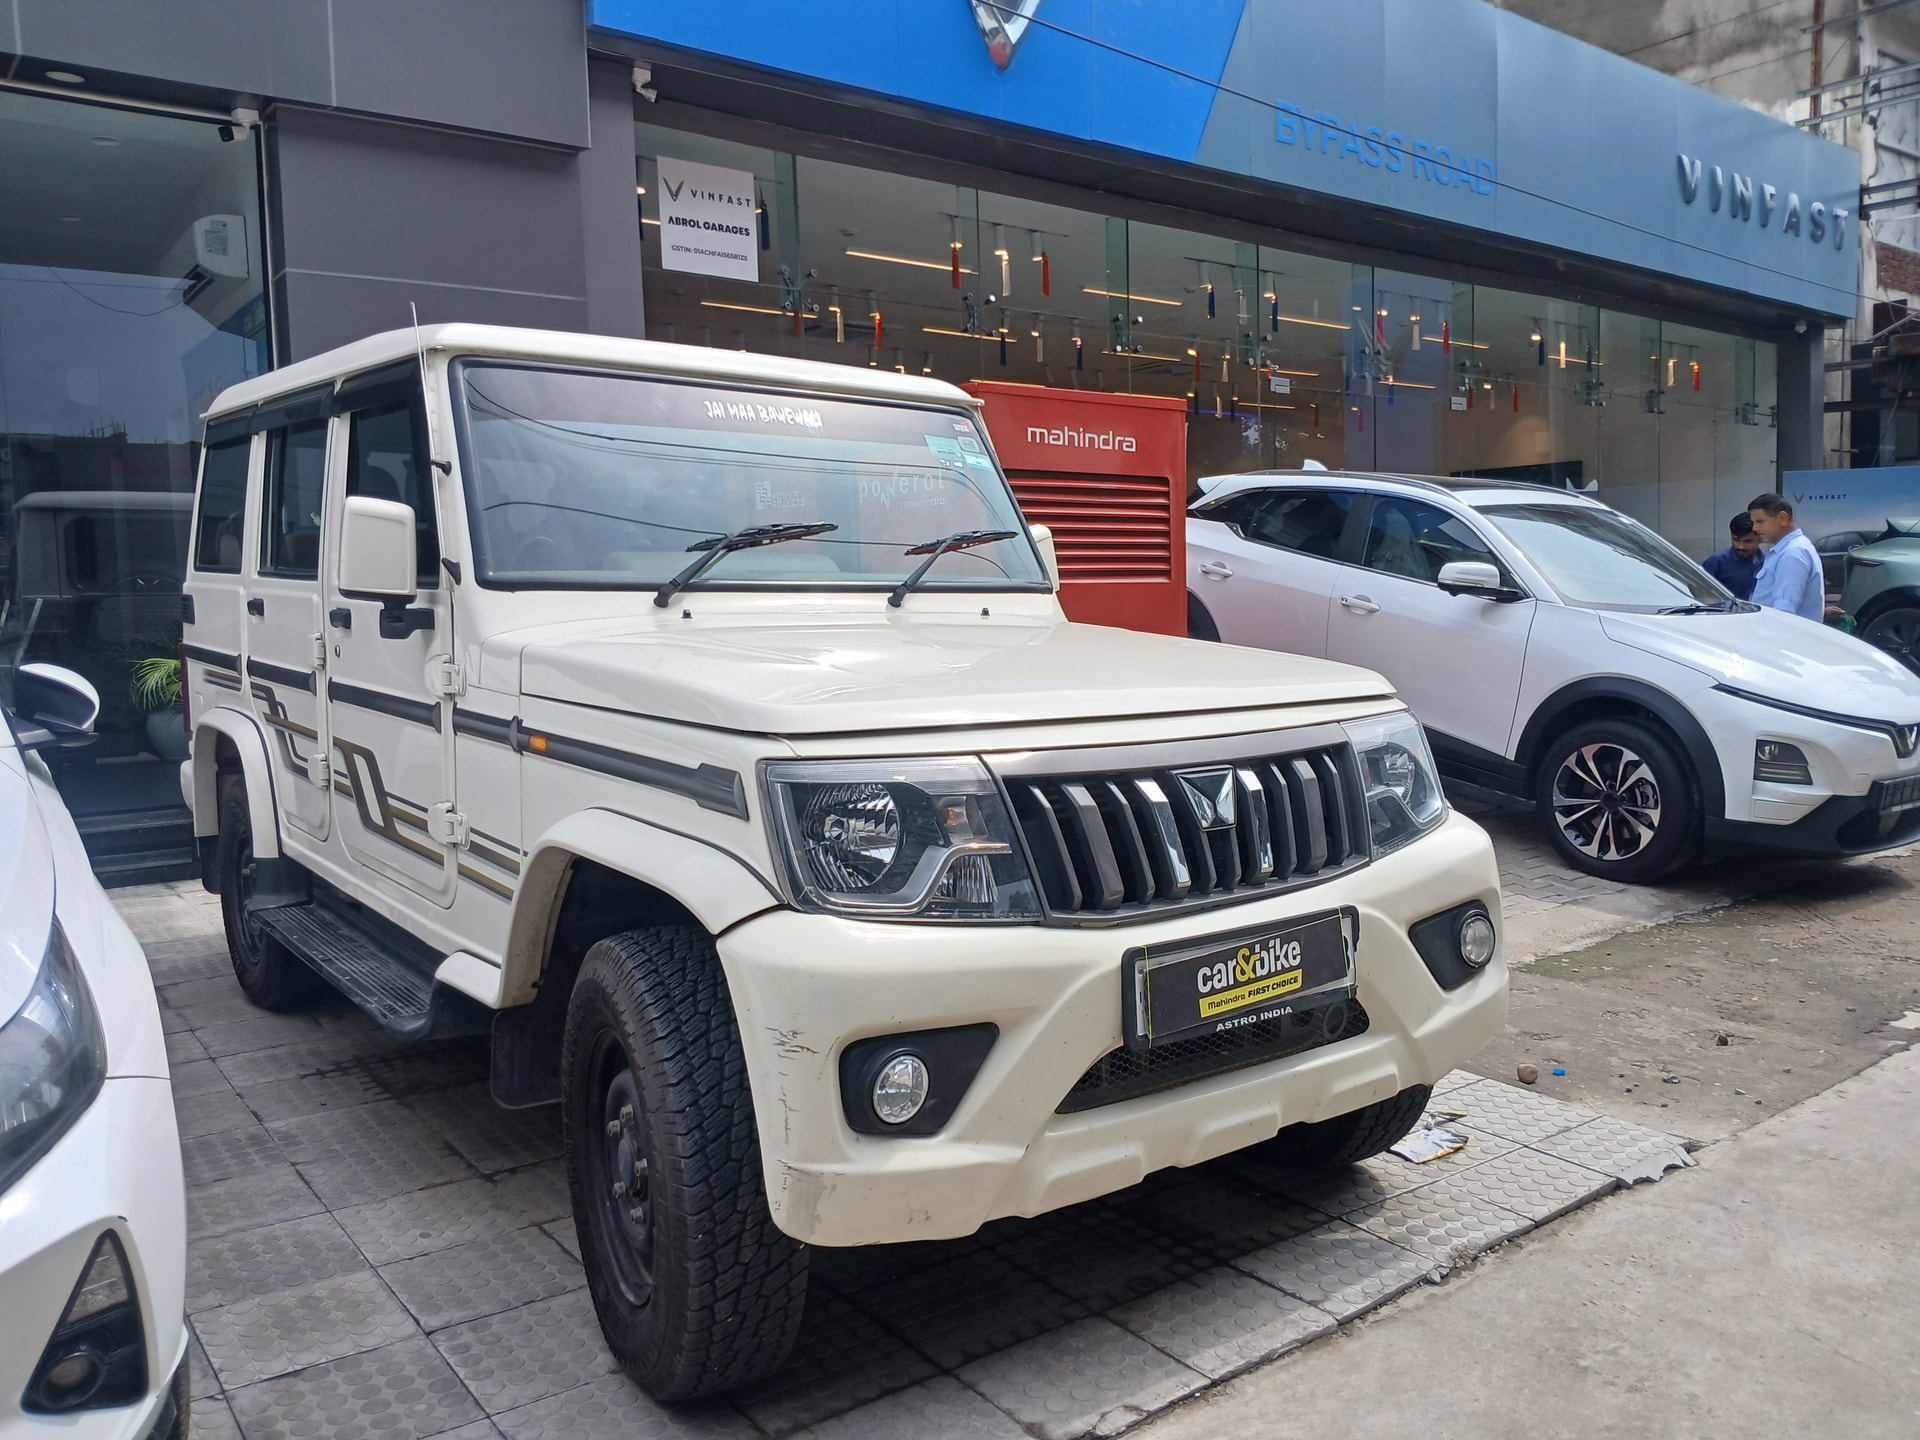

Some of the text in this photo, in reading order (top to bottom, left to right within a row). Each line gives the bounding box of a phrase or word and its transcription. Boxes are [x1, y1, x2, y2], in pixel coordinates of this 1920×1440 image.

[1275, 99, 1497, 197] BYPASS ROAD
[690, 188, 752, 208] VINFAST
[1677, 153, 1849, 251] VINFAST
[668, 215, 751, 237] ABROL GARAGES
[671, 244, 693, 254] GSTIN:
[703, 400, 727, 419] JAI
[727, 402, 757, 421] MAA
[1027, 425, 1137, 452] mahindra
[1197, 938, 1302, 993] car&bike
[1207, 975, 1299, 1011] Mahindra FIRST CHOICE
[1216, 1006, 1293, 1032] ASTRO INDIA
